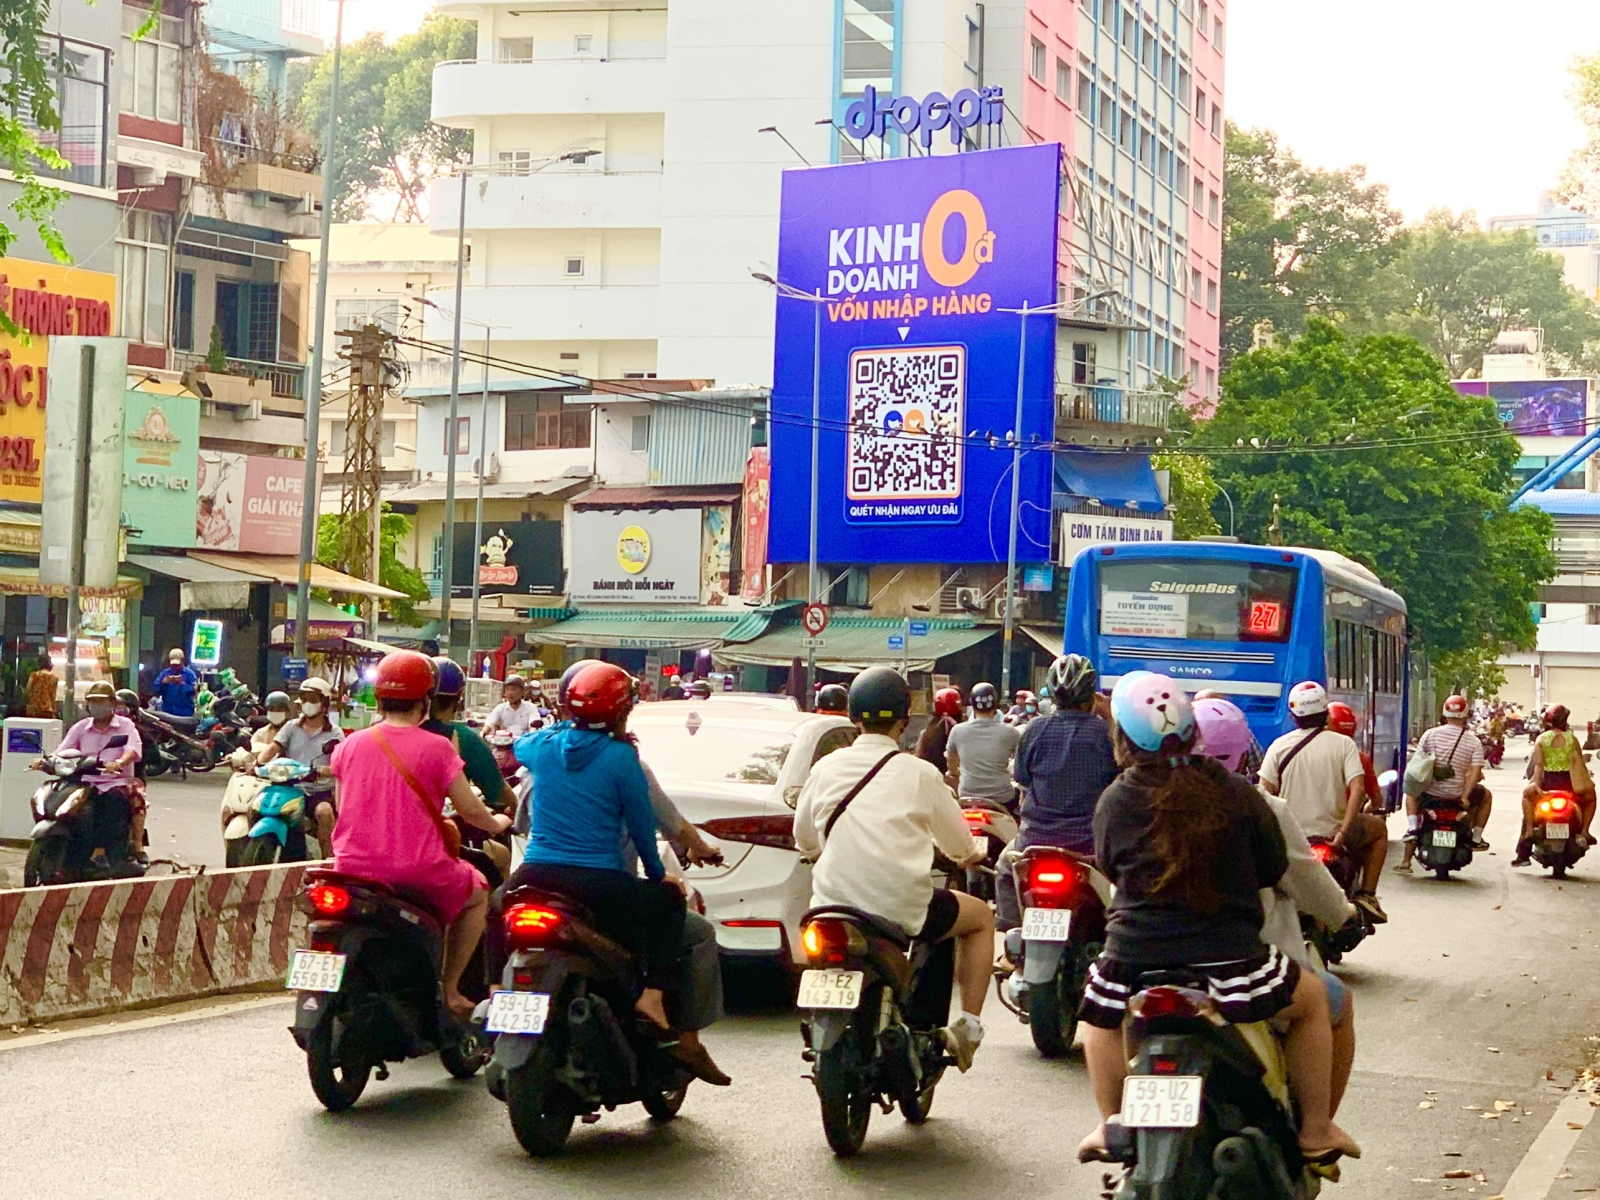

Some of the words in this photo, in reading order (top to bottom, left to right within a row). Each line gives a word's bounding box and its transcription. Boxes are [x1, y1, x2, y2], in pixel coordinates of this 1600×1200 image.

[845, 84, 1004, 148] droppii
[828, 222, 921, 267] KINH
[827, 263, 918, 295] DOANH
[827, 294, 869, 323] VỐN
[872, 292, 928, 324] NHẬP
[932, 289, 993, 316] HÀNG
[265, 475, 303, 494] CAFE
[247, 493, 276, 514] GIẢI
[850, 503, 874, 517] QUÉT
[875, 503, 900, 518] NHẬN
[901, 504, 926, 516] NGAY
[927, 503, 941, 515] ƯU
[942, 502, 958, 515] ĐÃI
[1071, 522, 1092, 539] CƠM
[1095, 521, 1117, 541] TẤM
[592, 578, 616, 591] BÁNH
[652, 578, 676, 591] NGÀY
[1149, 580, 1238, 595] SaigonBus
[1251, 603, 1279, 630] 27
[619, 638, 678, 649] BAKERY
[1030, 909, 1064, 925] 59-L2
[1024, 924, 1066, 939] 907.68
[299, 953, 338, 972] 67-E1
[291, 970, 338, 989] 559.83
[810, 971, 854, 989] 29-E2
[498, 994, 541, 1012] 59-L3
[804, 989, 855, 1006] 143.19
[490, 1012, 542, 1031] 442.58
[1136, 1080, 1189, 1101] 59-U2
[1128, 1102, 1194, 1123] 121.58
